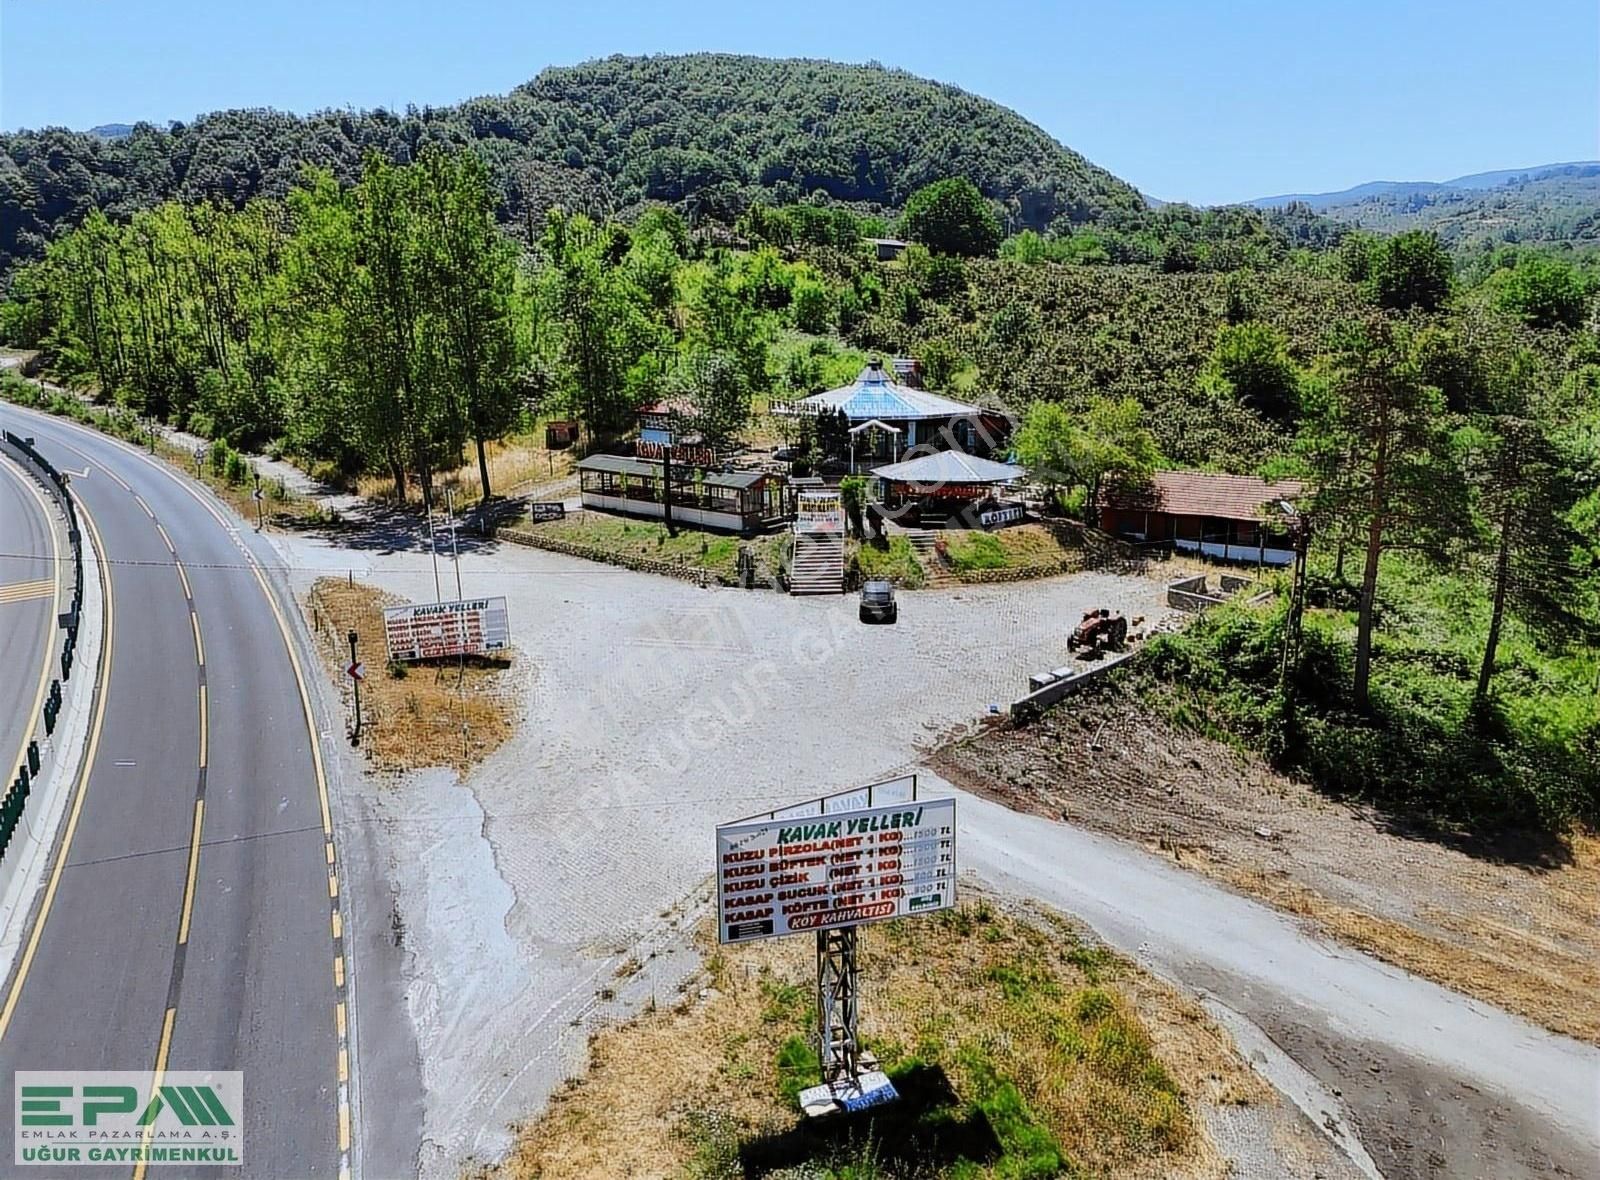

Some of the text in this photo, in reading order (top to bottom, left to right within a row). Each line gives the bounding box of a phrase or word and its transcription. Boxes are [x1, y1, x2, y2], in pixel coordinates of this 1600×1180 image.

[414, 605, 447, 616] KAVAK
[777, 821, 841, 844] KAVAK
[847, 807, 923, 835] YELLERİ
[723, 850, 765, 864] KUZU
[940, 826, 951, 835] TL
[724, 864, 765, 878] KUZU
[724, 879, 765, 893] KUZU
[940, 854, 951, 862] TL
[778, 885, 829, 901] SUCUK
[821, 903, 892, 924] KAHVALTISI
